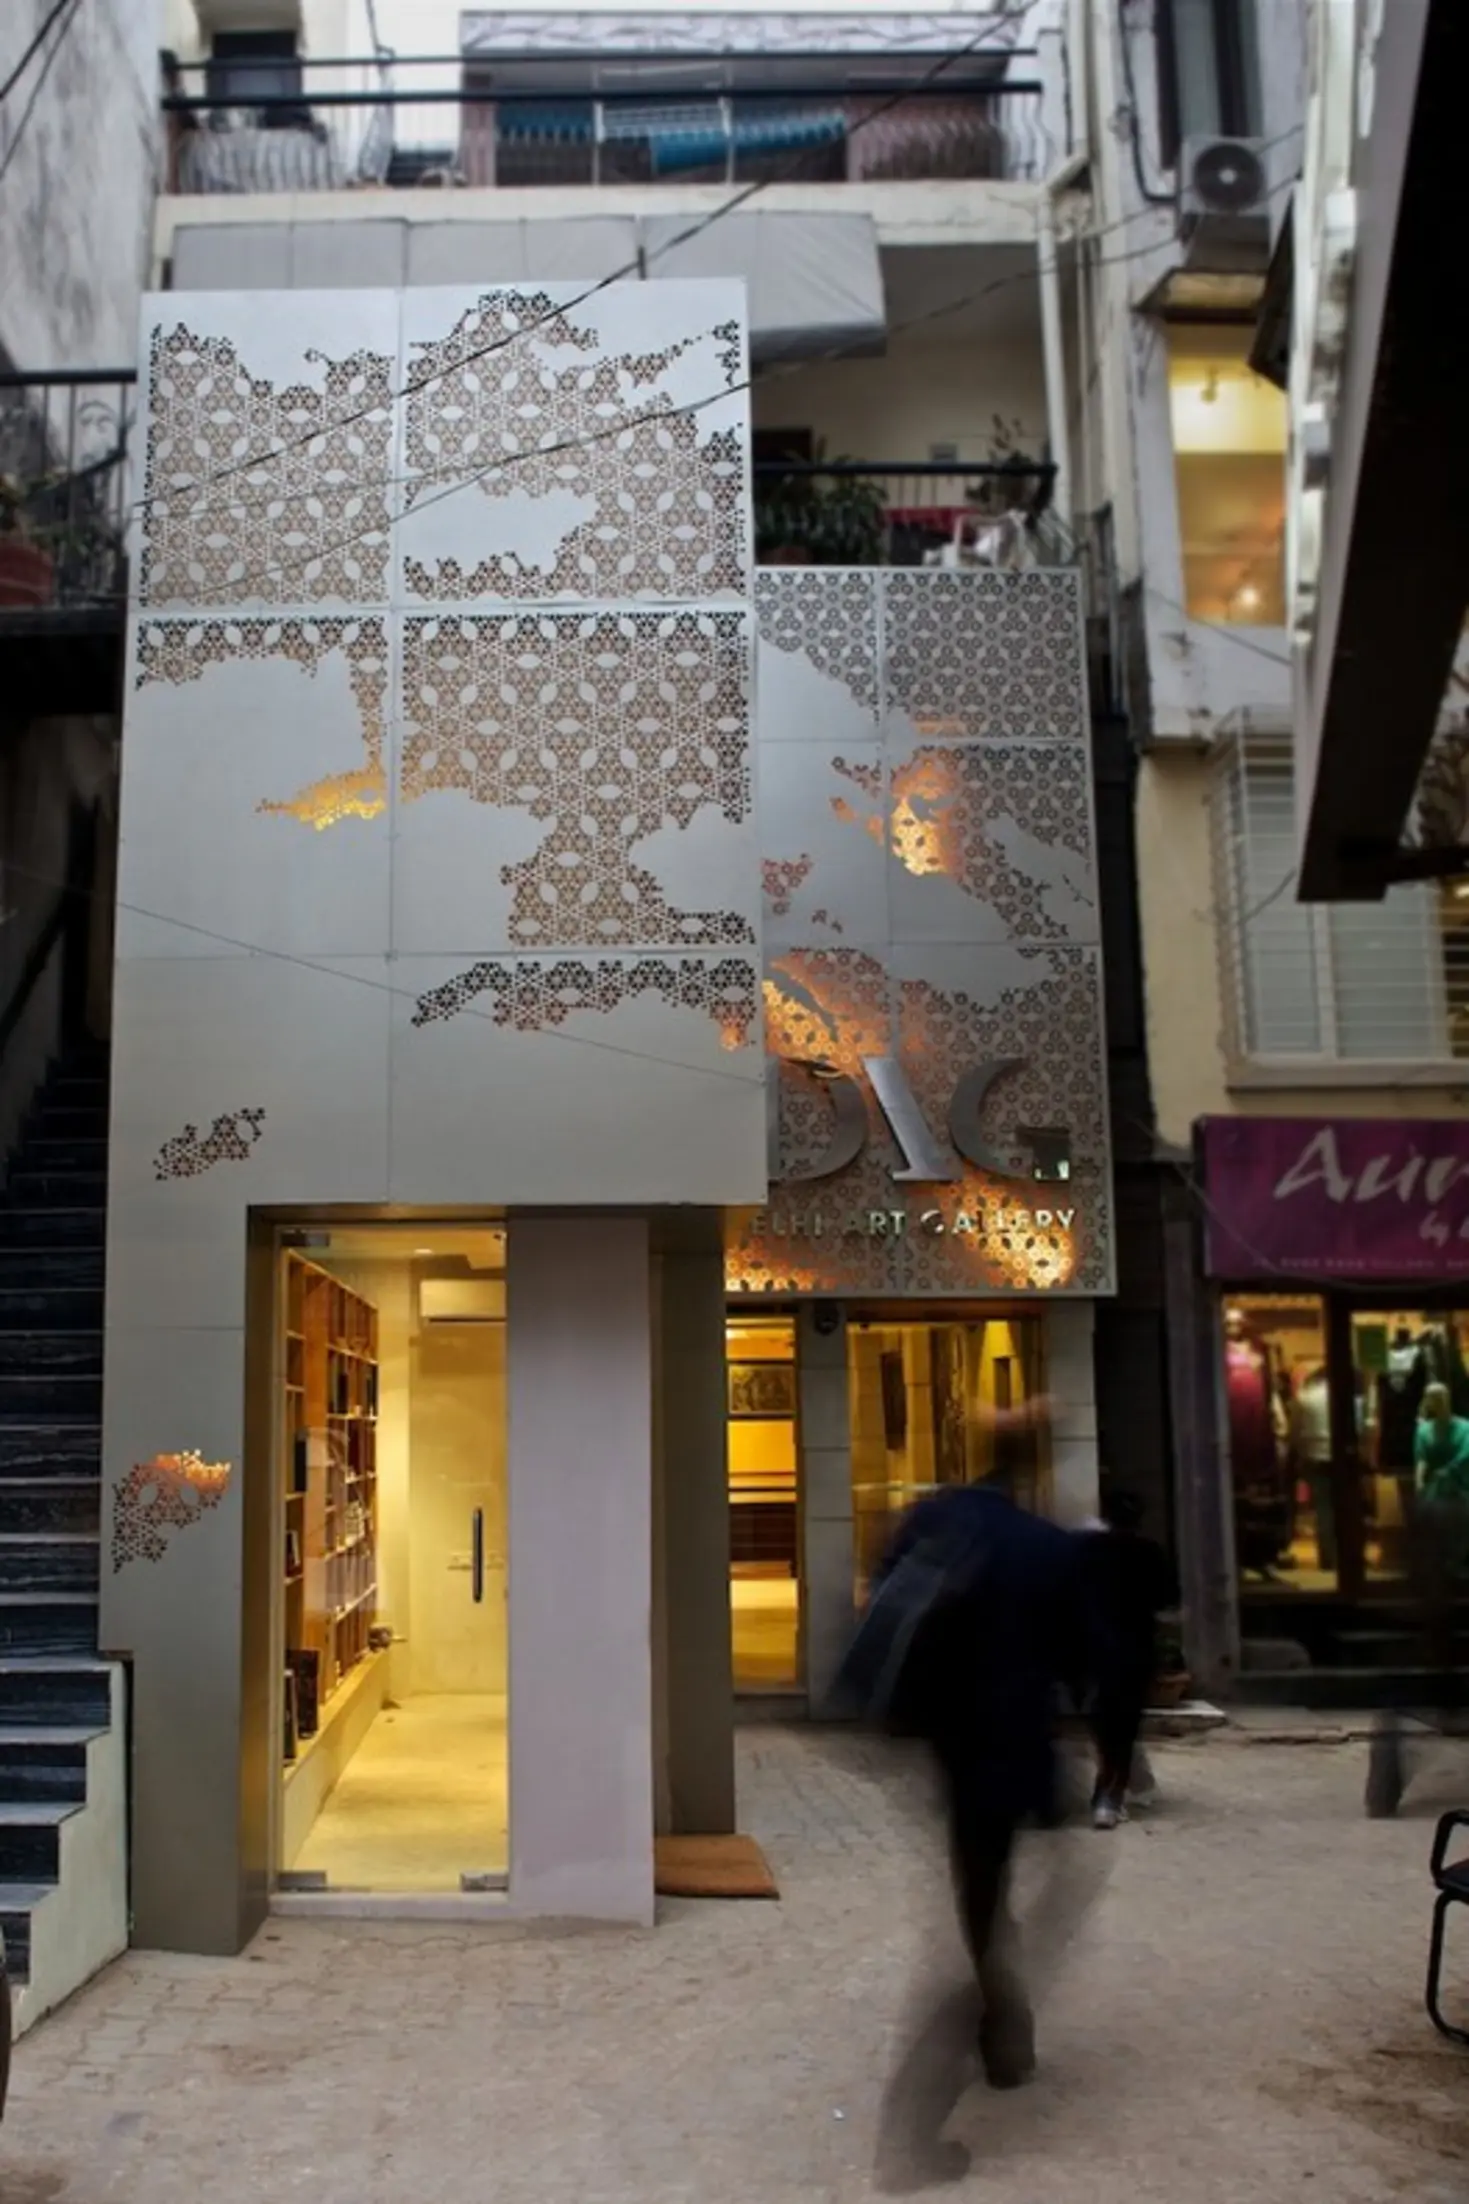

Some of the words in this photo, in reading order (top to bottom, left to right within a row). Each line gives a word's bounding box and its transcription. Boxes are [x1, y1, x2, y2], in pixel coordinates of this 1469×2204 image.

[750, 1210, 822, 1236] ELHI
[842, 1209, 905, 1236] ART
[920, 1208, 1075, 1237] GALLERY
